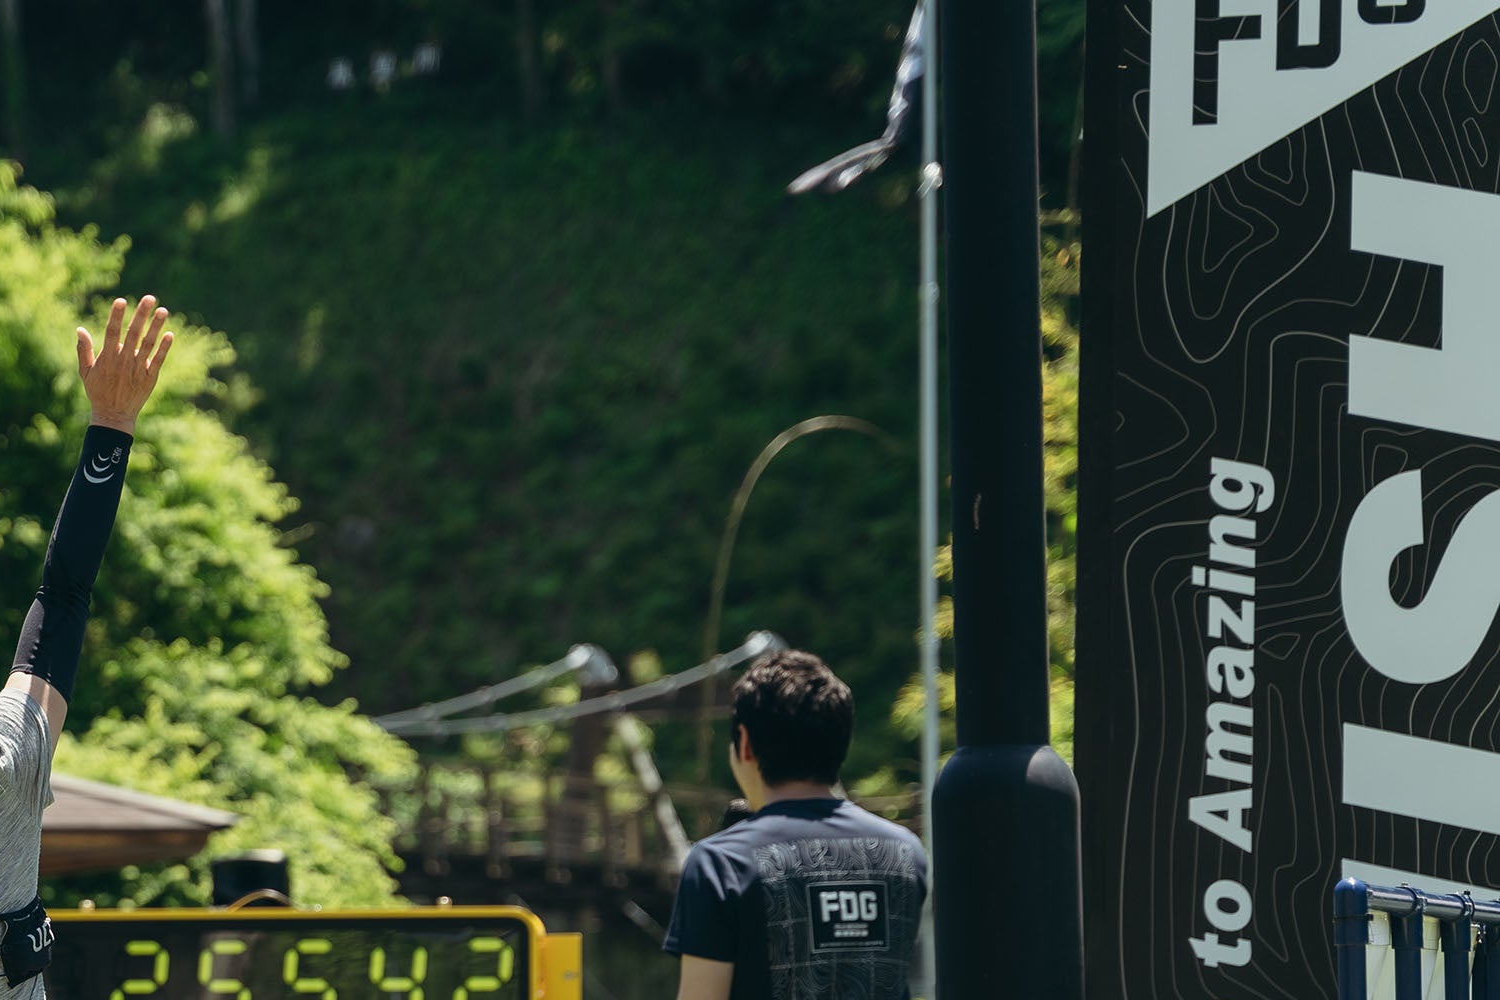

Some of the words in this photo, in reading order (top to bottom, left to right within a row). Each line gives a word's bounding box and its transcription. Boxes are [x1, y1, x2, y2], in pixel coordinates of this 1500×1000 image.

[1187, 456, 1275, 854] Amazing
[819, 890, 878, 923] FDG
[1188, 878, 1253, 968] to
